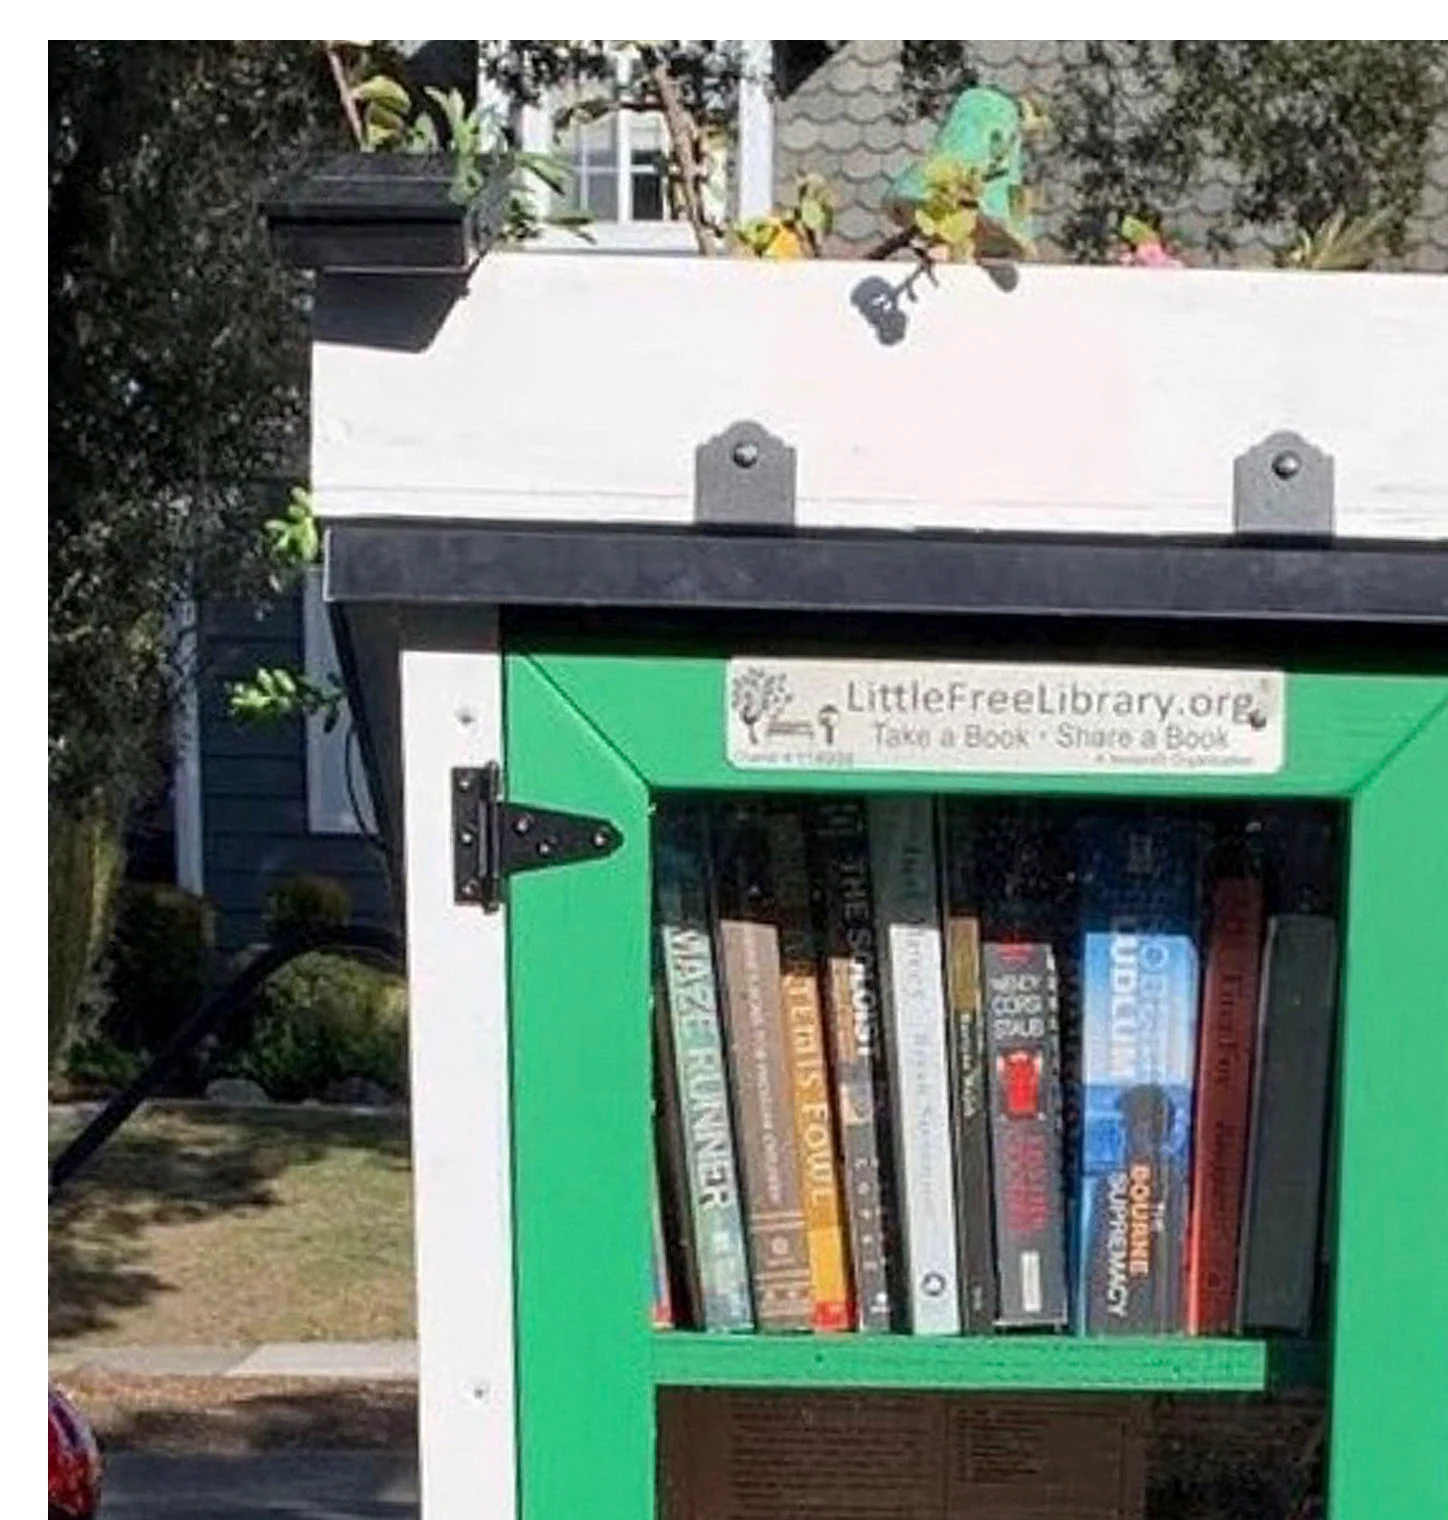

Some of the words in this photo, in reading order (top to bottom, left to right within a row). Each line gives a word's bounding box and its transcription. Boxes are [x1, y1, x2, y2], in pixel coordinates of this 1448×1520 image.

[847, 679, 1254, 724] LittleFreeLibrary.org
[873, 721, 931, 748] Take
[939, 727, 955, 747] a
[965, 723, 1029, 750] Book
[1056, 721, 1132, 748] Share
[1140, 728, 1157, 748] a
[1165, 724, 1228, 750] Book
[684, 1048, 730, 1213] RUNNER
[800, 1101, 835, 1208] FOWL
[1105, 1170, 1130, 1320] SUPREMACY
[1128, 1158, 1151, 1278] BOURNE
